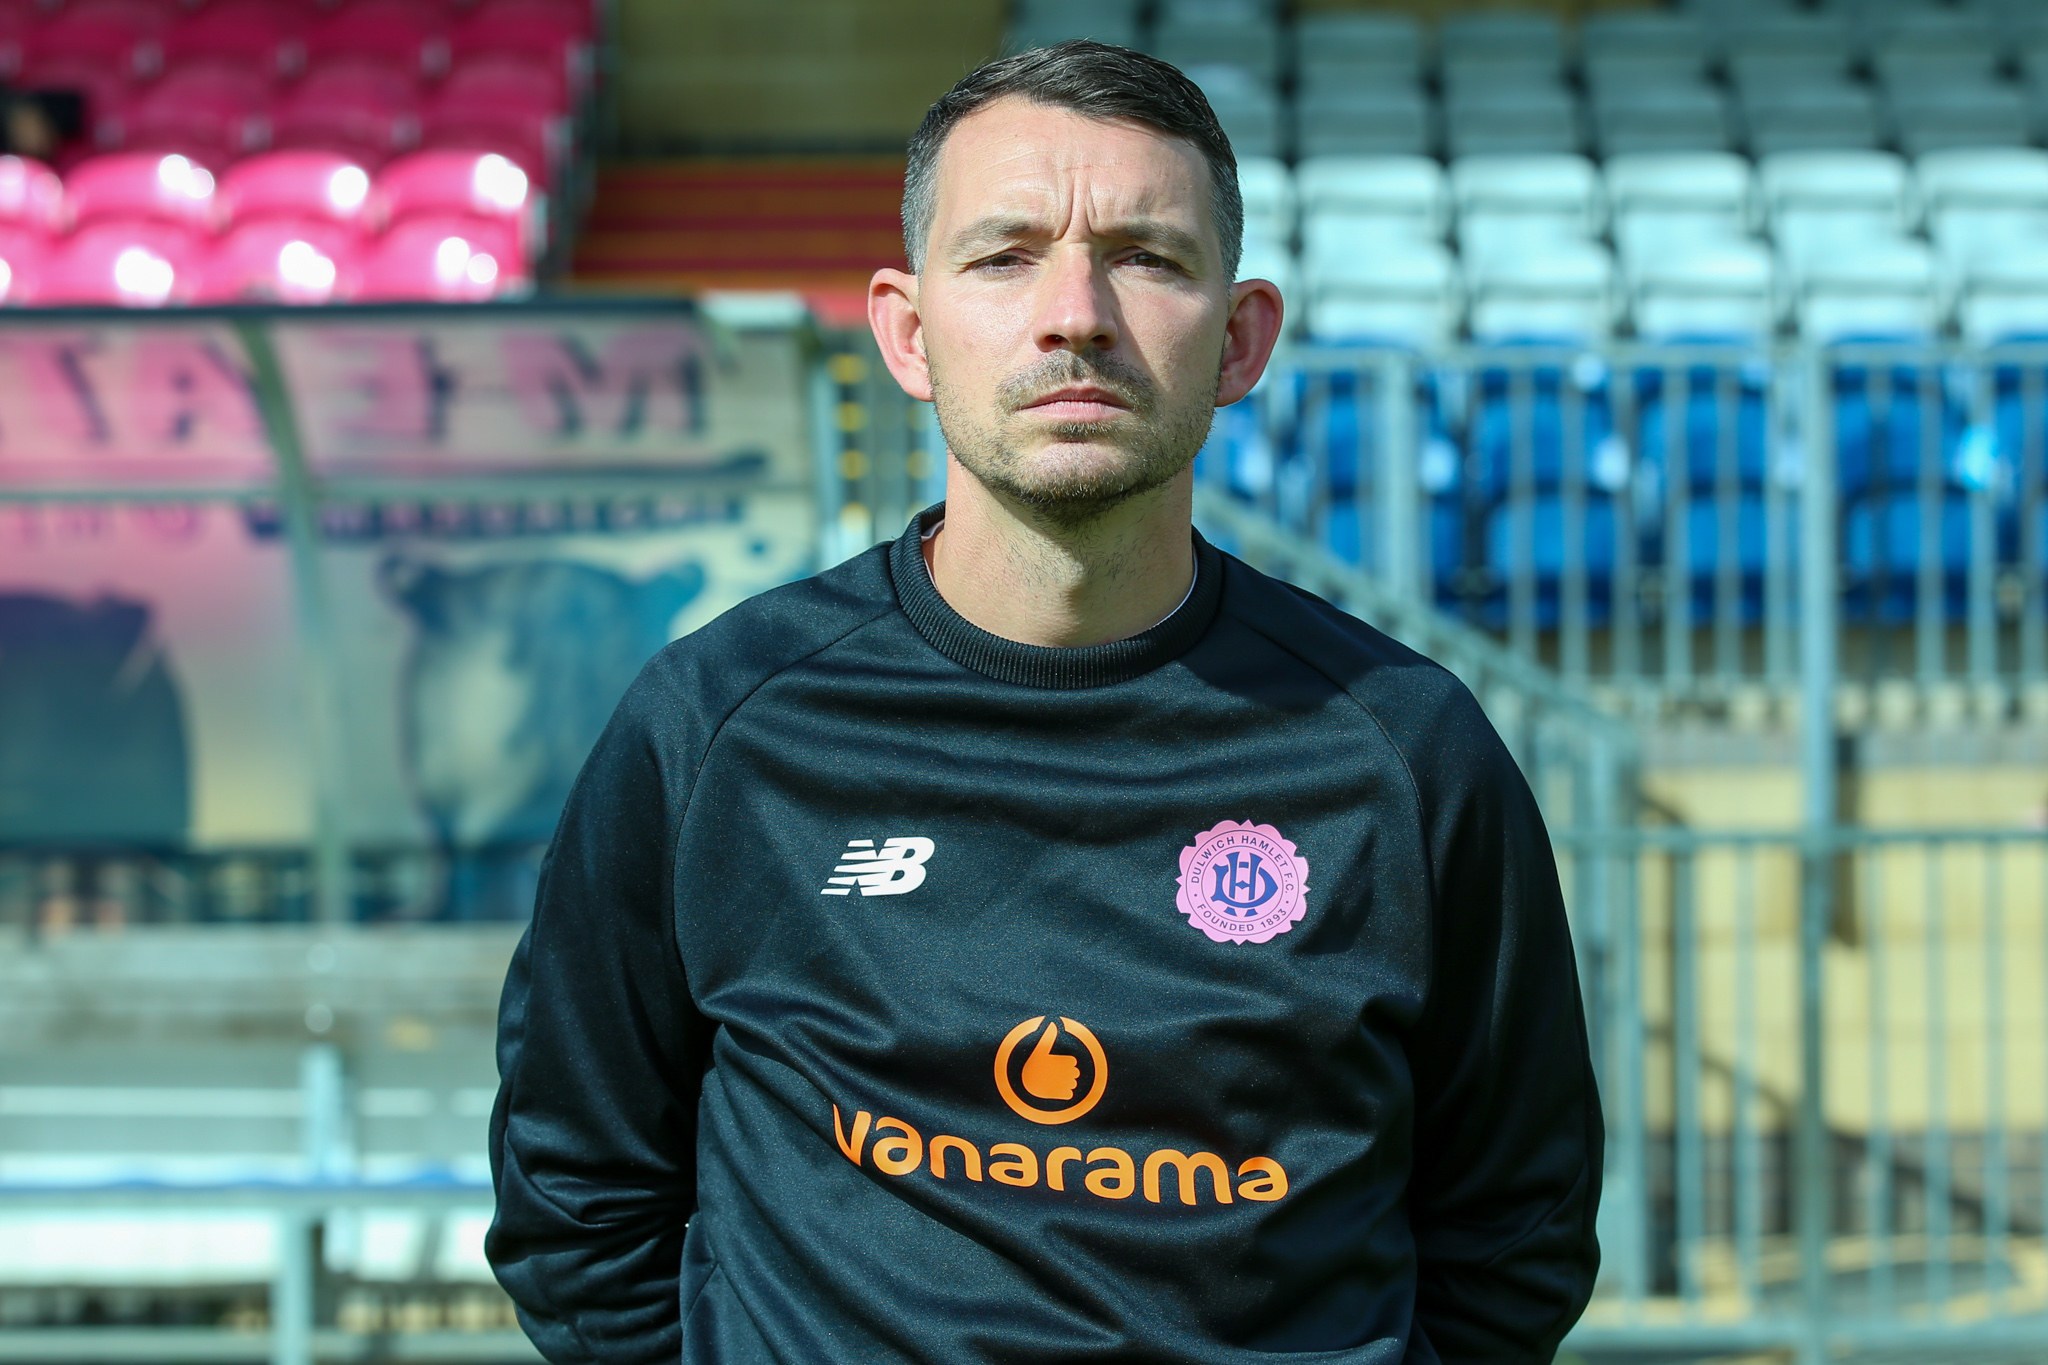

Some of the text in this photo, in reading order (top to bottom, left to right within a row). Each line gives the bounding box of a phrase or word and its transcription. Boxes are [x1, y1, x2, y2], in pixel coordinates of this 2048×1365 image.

[820, 836, 936, 897] NB
[1191, 835, 1294, 894] DULWICH HAMLET F.C.
[1197, 903, 1286, 932] FOUNDED 1893
[832, 1103, 1289, 1205] vanarama
